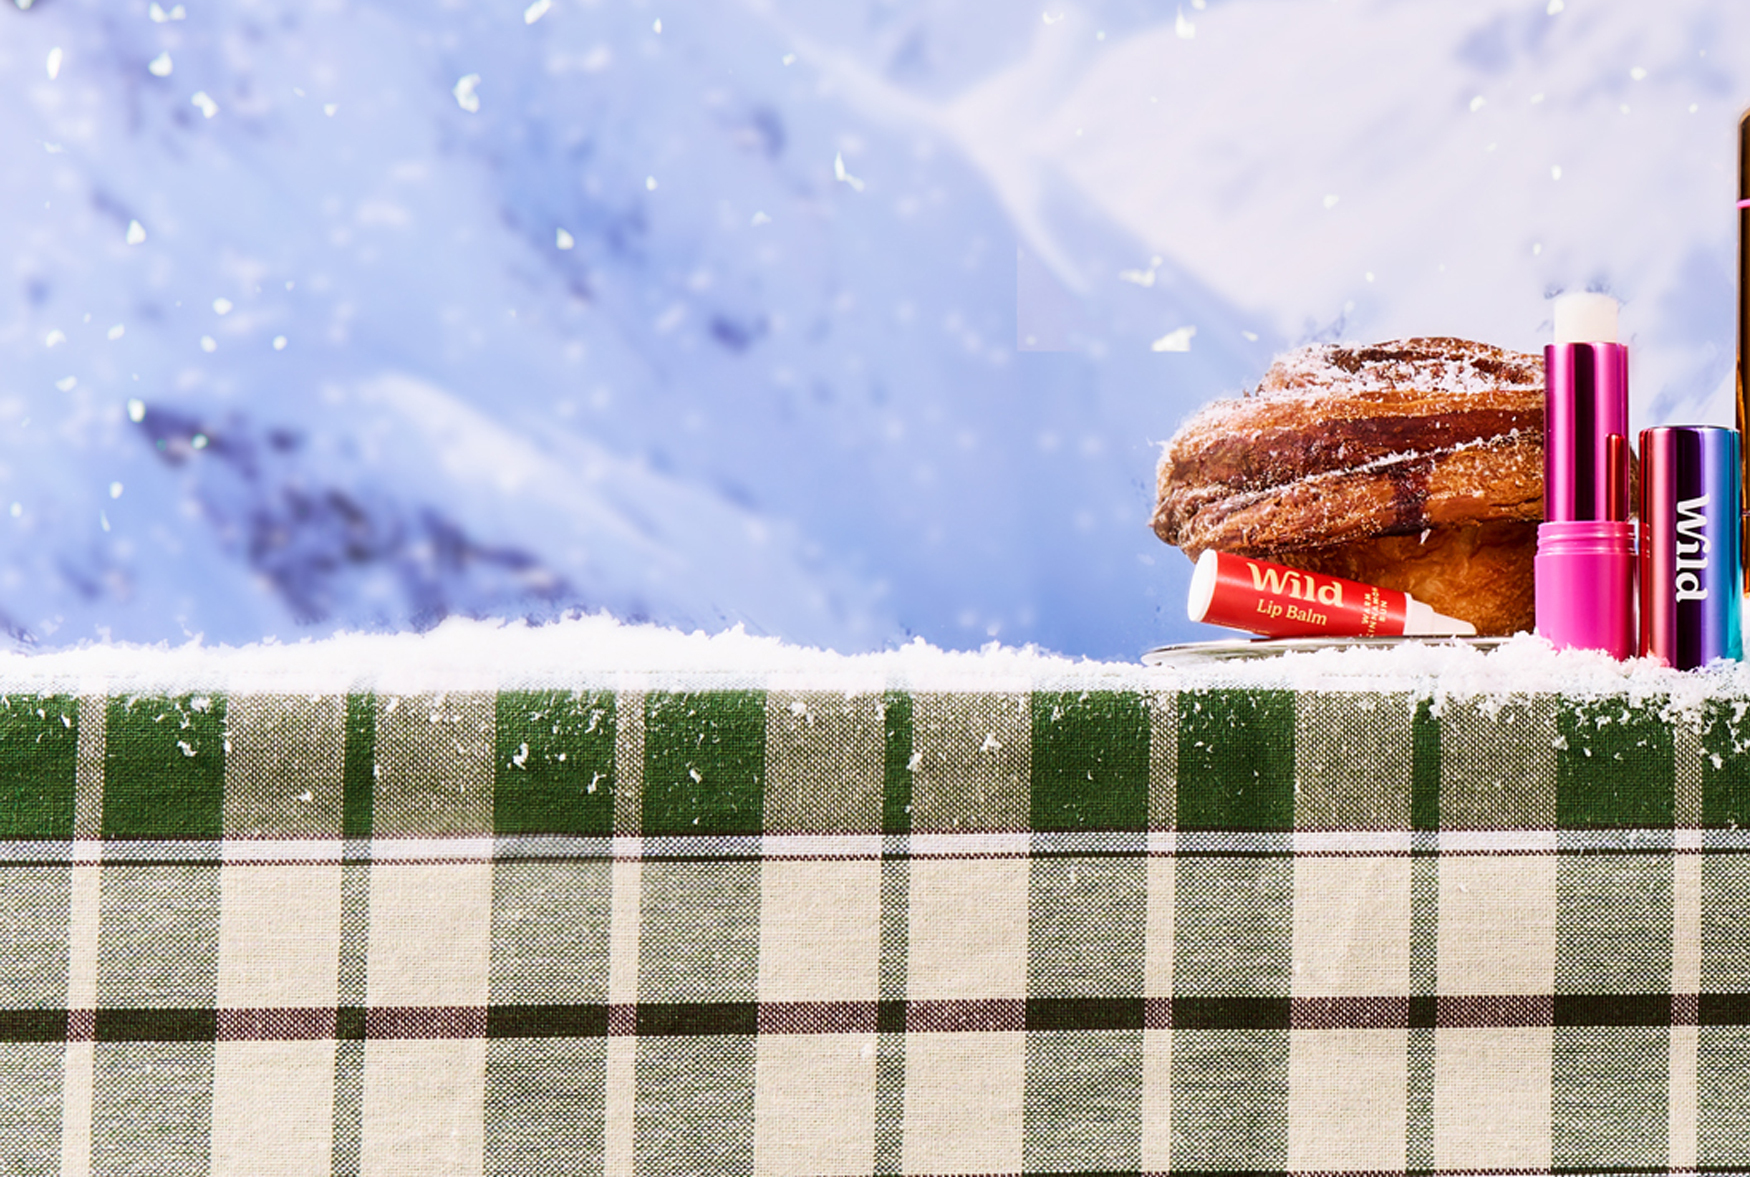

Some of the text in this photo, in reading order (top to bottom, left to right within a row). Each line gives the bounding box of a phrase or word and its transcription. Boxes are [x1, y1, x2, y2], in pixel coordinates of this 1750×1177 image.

[1675, 493, 1711, 602] Wild
[1247, 562, 1344, 607] Wild
[1257, 598, 1328, 626] Lip Balm
